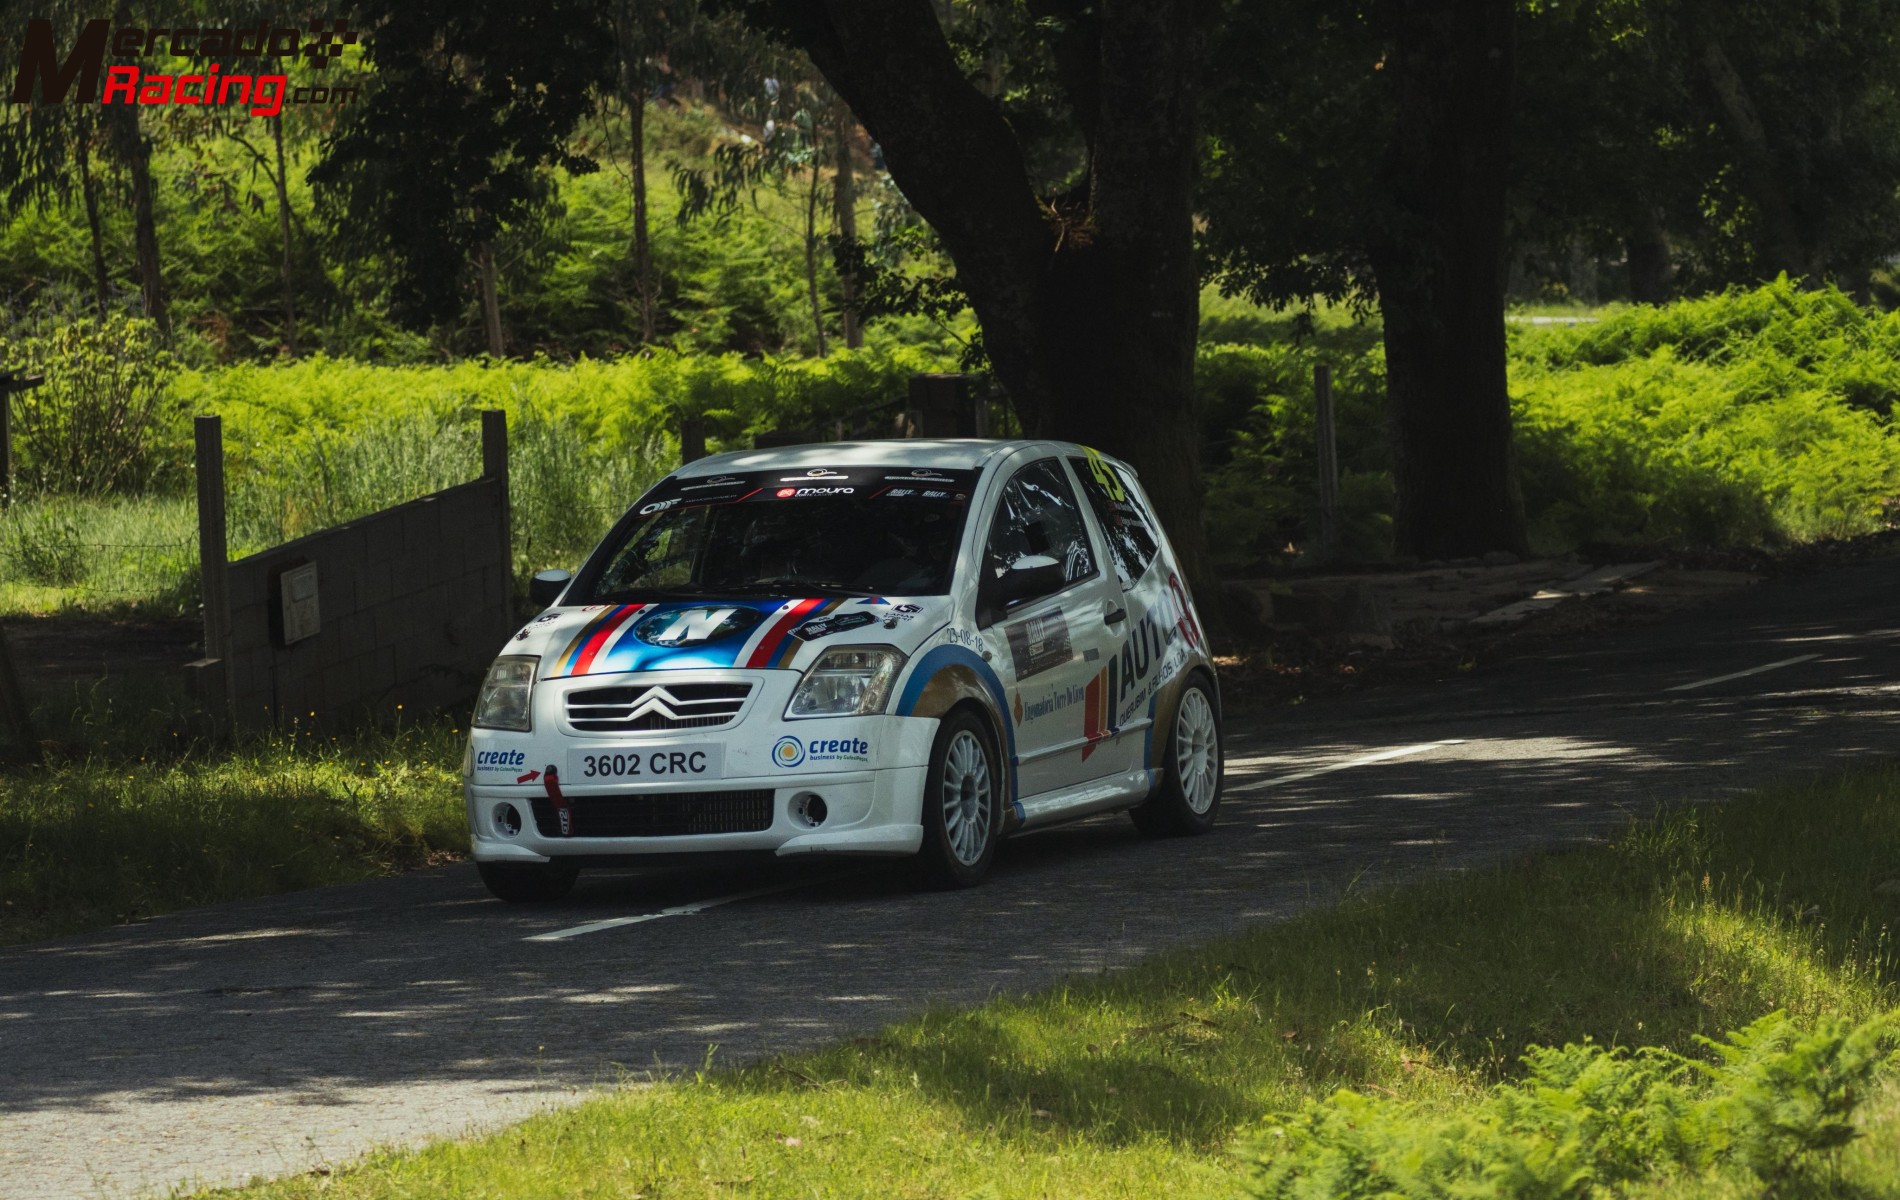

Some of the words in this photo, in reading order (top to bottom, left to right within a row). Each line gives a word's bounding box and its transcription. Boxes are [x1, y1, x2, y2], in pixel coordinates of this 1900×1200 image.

[947, 627, 983, 652] 23-08-18
[809, 737, 868, 755] create
[477, 749, 525, 765] create
[583, 753, 640, 777] 3602
[650, 751, 707, 774] CRC
